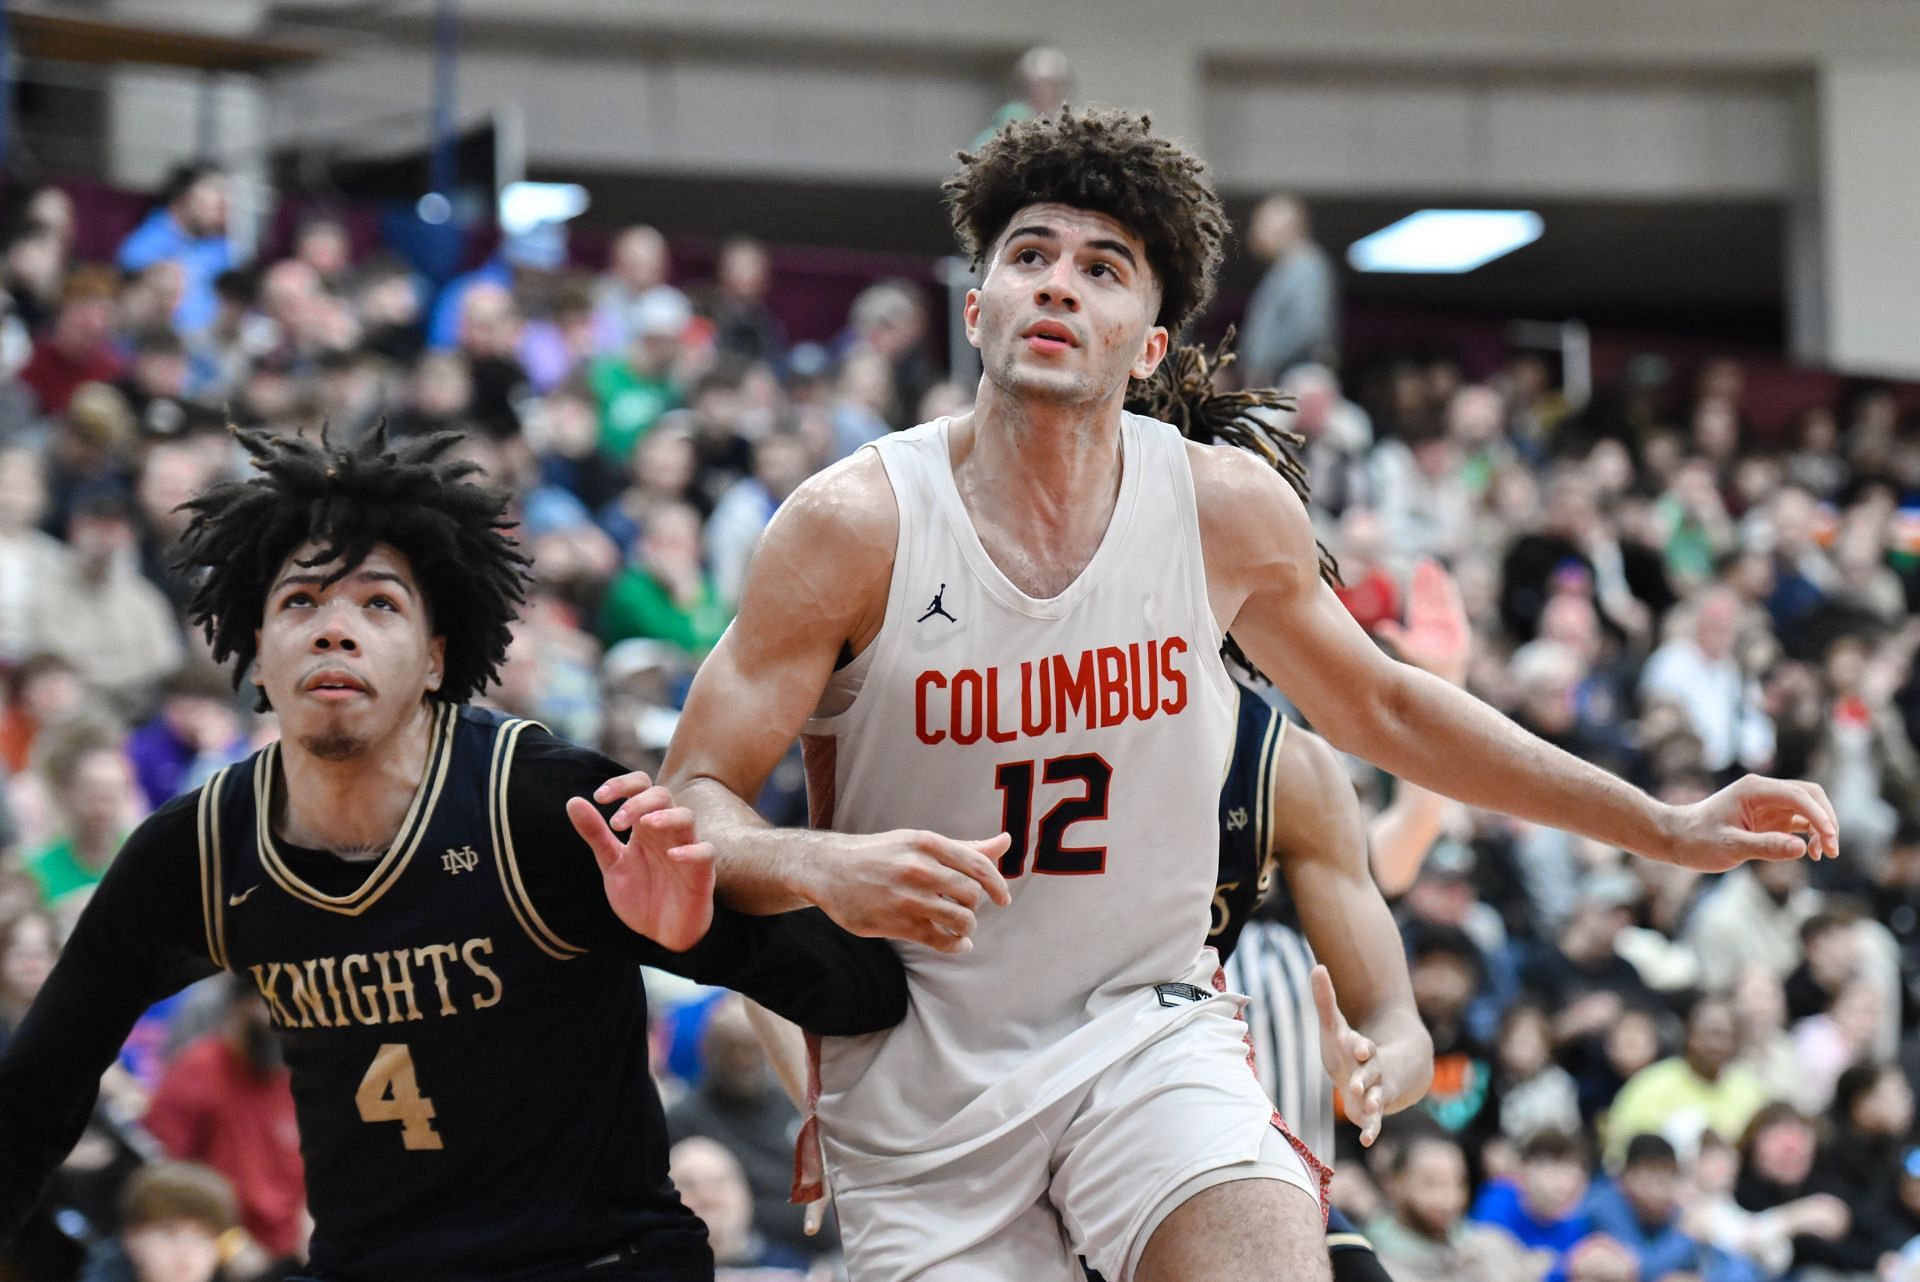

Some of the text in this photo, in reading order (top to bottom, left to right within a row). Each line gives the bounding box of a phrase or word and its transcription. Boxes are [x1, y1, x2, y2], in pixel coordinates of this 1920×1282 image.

[915, 636, 1188, 745] COLUMBUS
[994, 752, 1113, 879] 12
[249, 937, 503, 1028] KNIGHTS
[355, 1043, 444, 1150] 4
